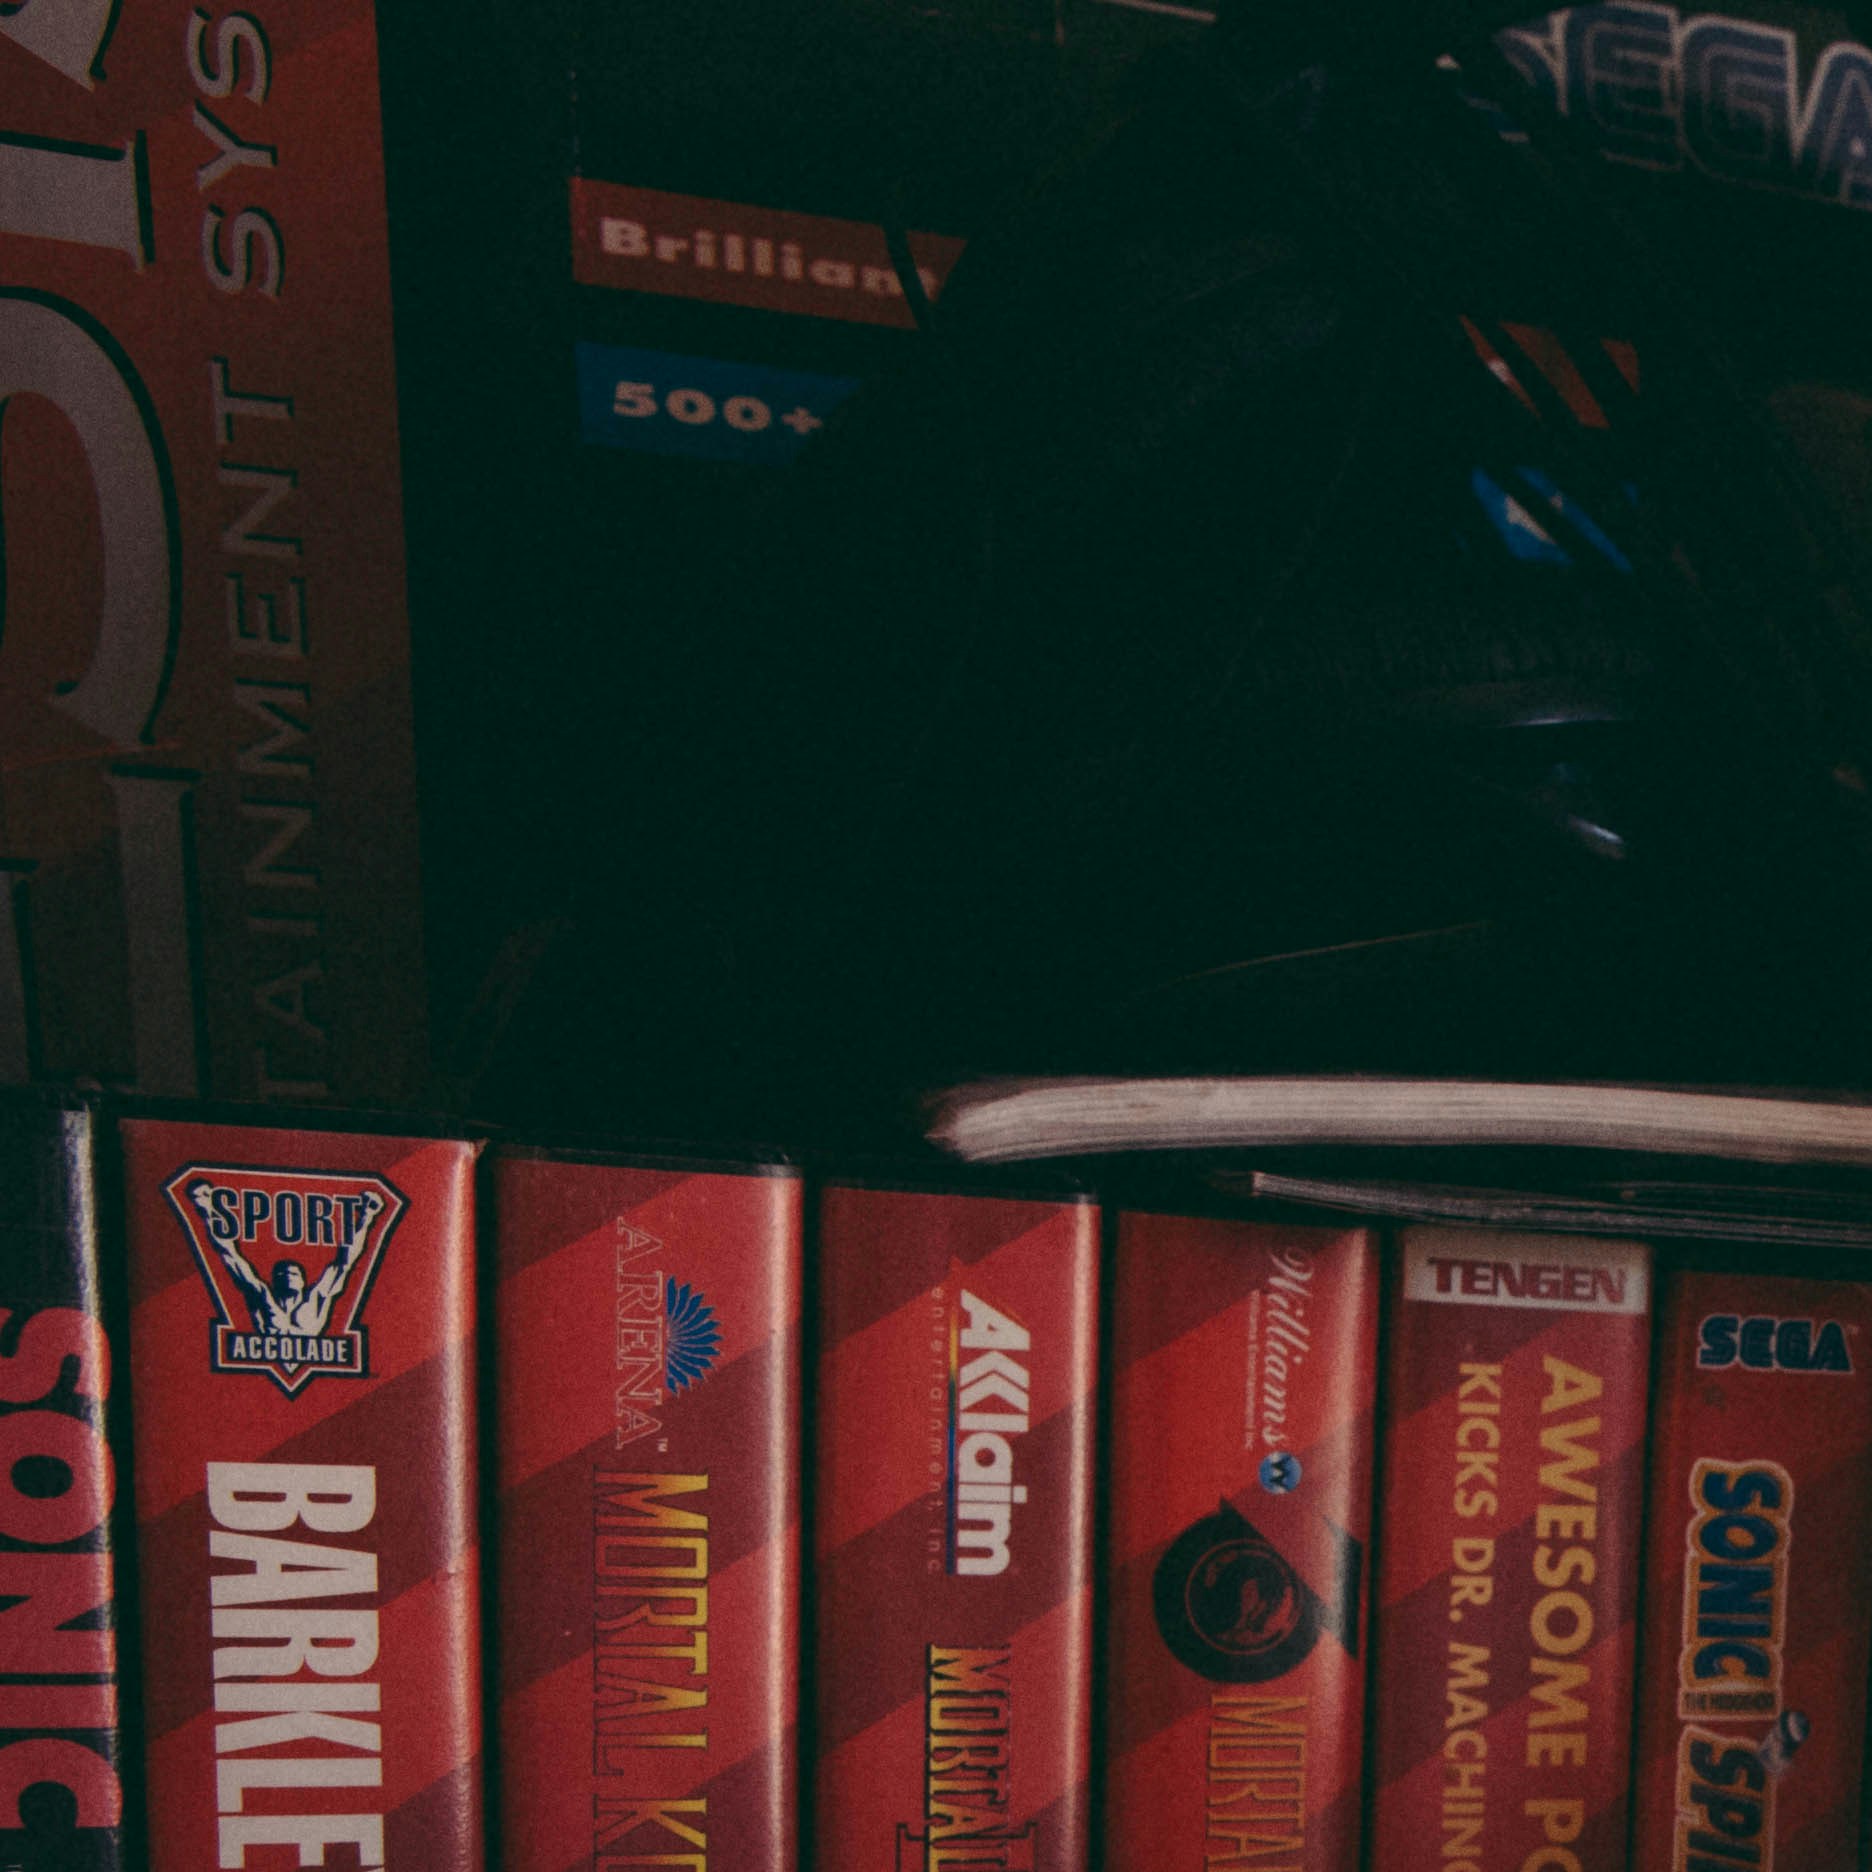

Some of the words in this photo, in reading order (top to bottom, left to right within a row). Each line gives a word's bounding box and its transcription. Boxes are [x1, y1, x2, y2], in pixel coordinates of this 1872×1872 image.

[612, 380, 824, 436] 500+
[208, 1186, 364, 1248] SPORT
[1429, 1256, 1628, 1306] TENGEN
[231, 1335, 349, 1366] ACCOLADE
[613, 1216, 665, 1452] ARENA
[1262, 1247, 1315, 1447] Williams
[1698, 1315, 1853, 1375] SEGA
[1453, 1362, 1503, 1521] KICKS
[0, 1307, 121, 1831] SONIC
[592, 1471, 710, 1778] MORTAL
[1446, 1536, 1496, 1625] DR.
[1526, 1354, 1602, 1768] AWESOME
[1690, 1465, 1787, 1692] SONIC
